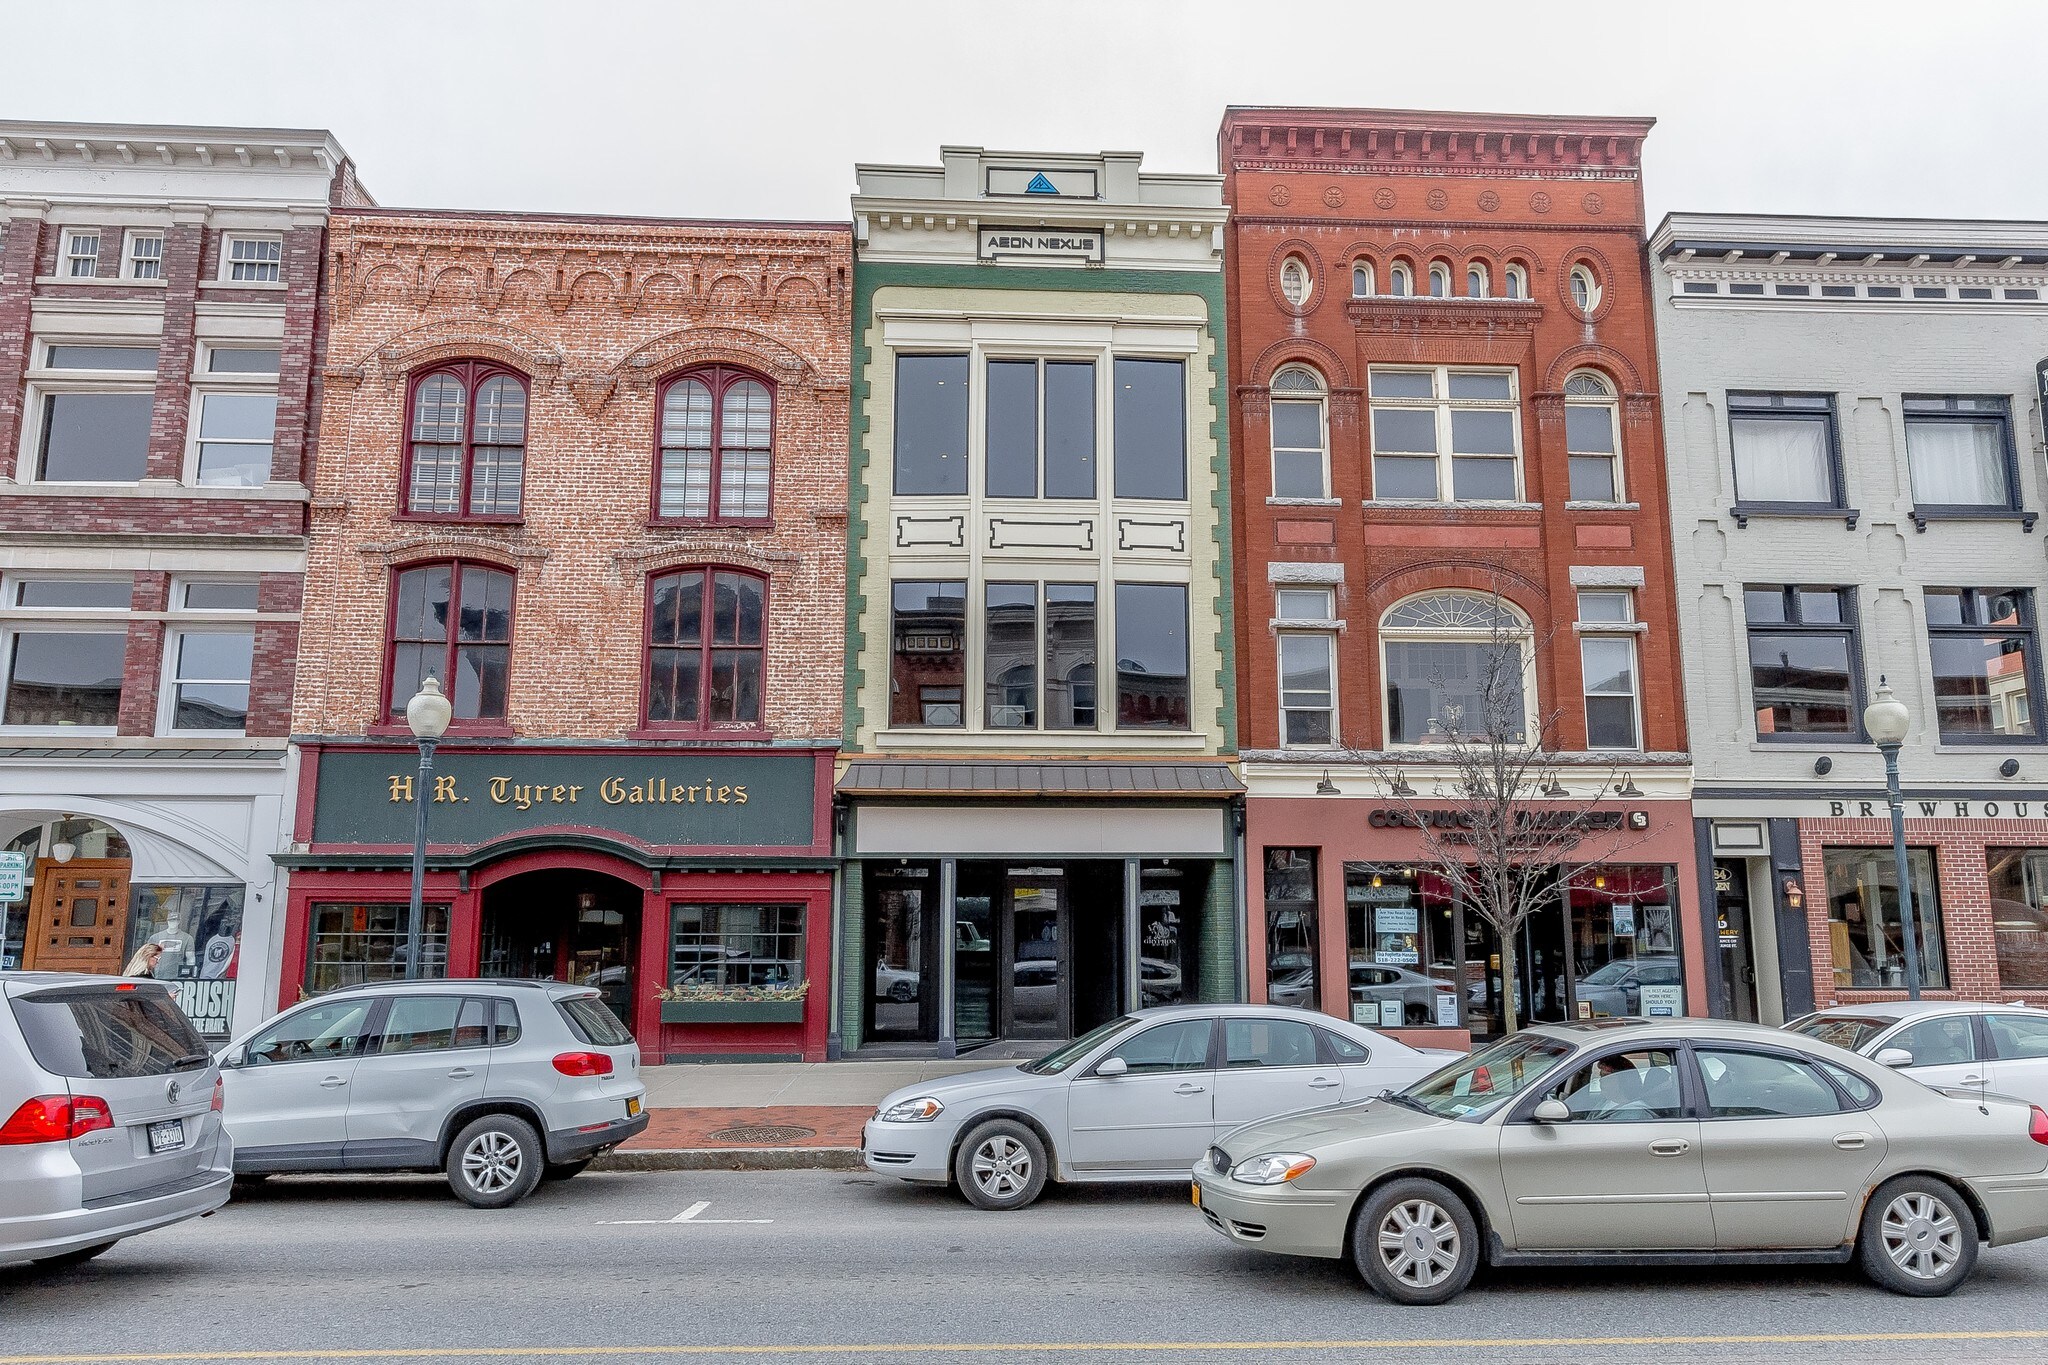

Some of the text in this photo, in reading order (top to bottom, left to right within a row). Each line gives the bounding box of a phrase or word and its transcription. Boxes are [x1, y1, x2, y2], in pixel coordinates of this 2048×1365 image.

[988, 237, 1094, 250] AEON NEXUS
[388, 775, 749, 810] H R. Tyrer Galleries
[1830, 802, 2048, 817] BRWHOU
[11, 882, 19, 890] PM
[1716, 882, 1731, 891] EN
